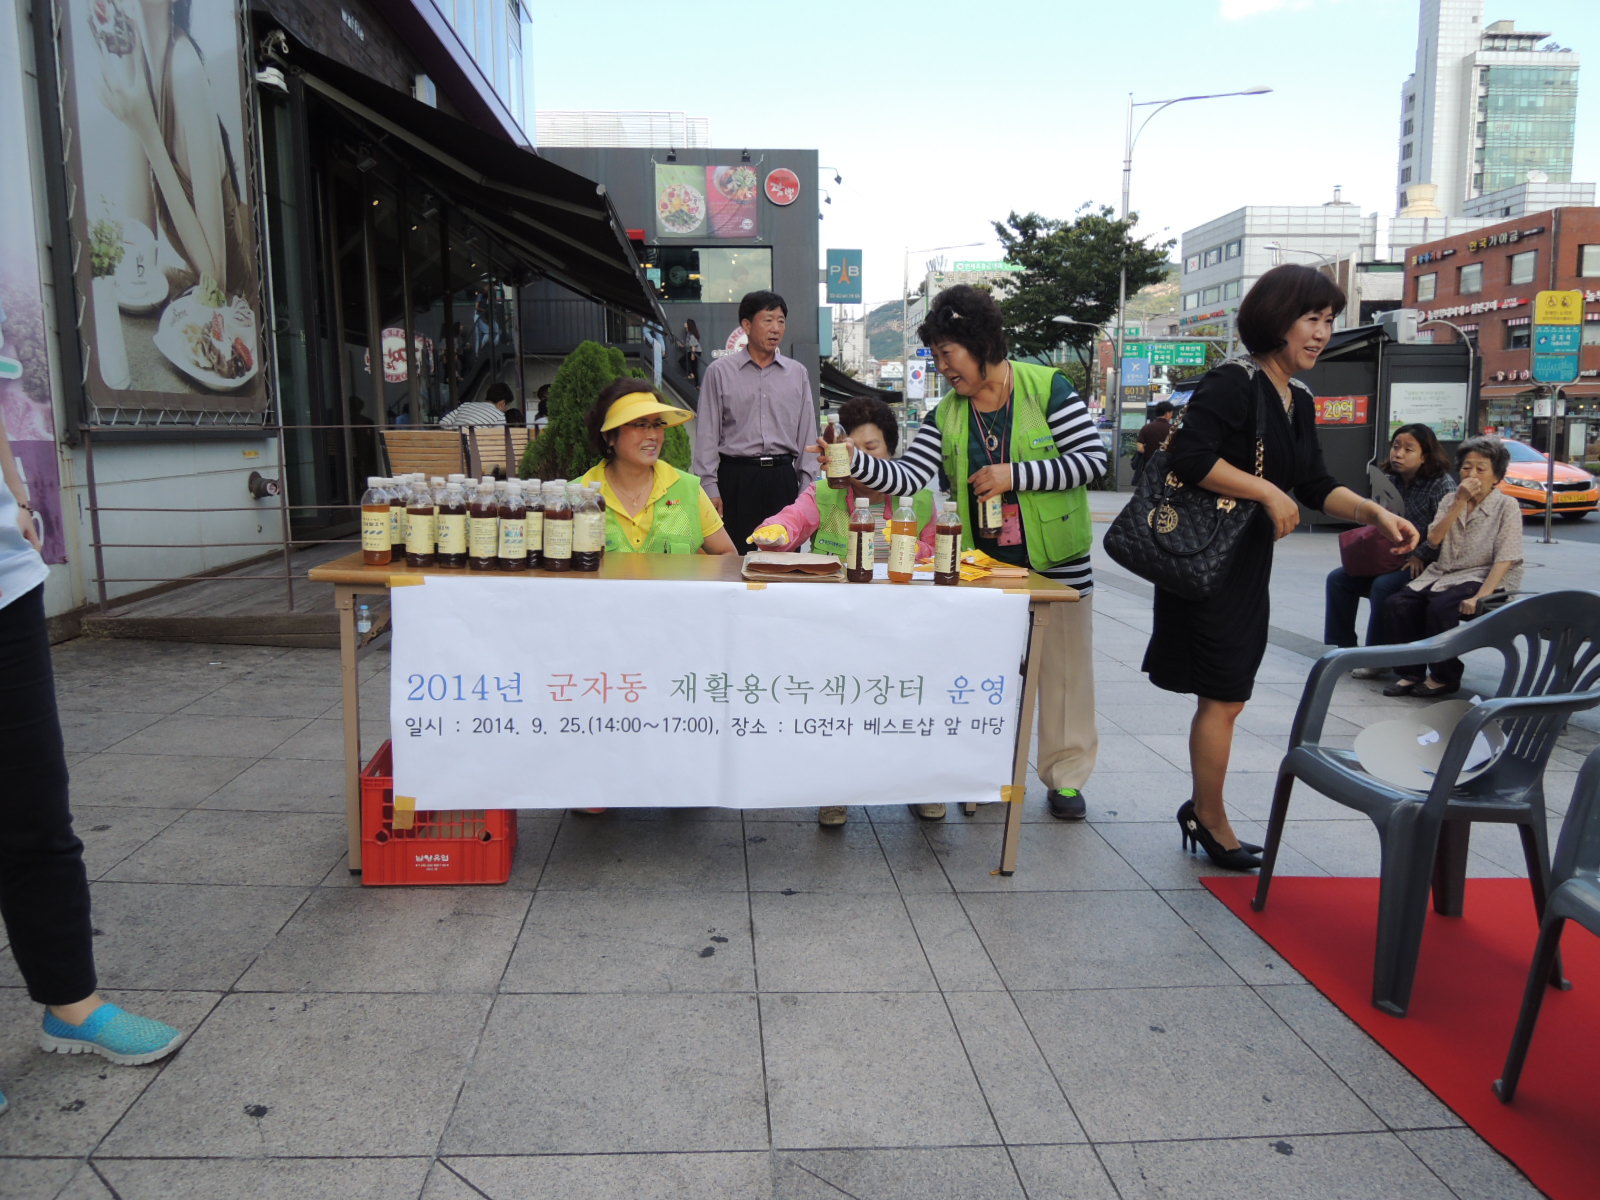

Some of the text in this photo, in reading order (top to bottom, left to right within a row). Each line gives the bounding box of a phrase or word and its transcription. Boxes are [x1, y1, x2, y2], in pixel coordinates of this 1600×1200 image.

[1124, 386, 1145, 395] 6013
[1324, 399, 1355, 421] 20억
[408, 672, 1005, 705] 2014년 군자동 재활용(녹색)장터 운영
[405, 717, 443, 737] 일시
[473, 717, 520, 735] 2014.
[532, 717, 548, 735] 9.
[732, 717, 768, 736] 장소
[795, 717, 854, 736] LG전자
[864, 717, 935, 736] 베스트샵
[945, 717, 962, 736] 앞
[971, 717, 1006, 736] 마당
